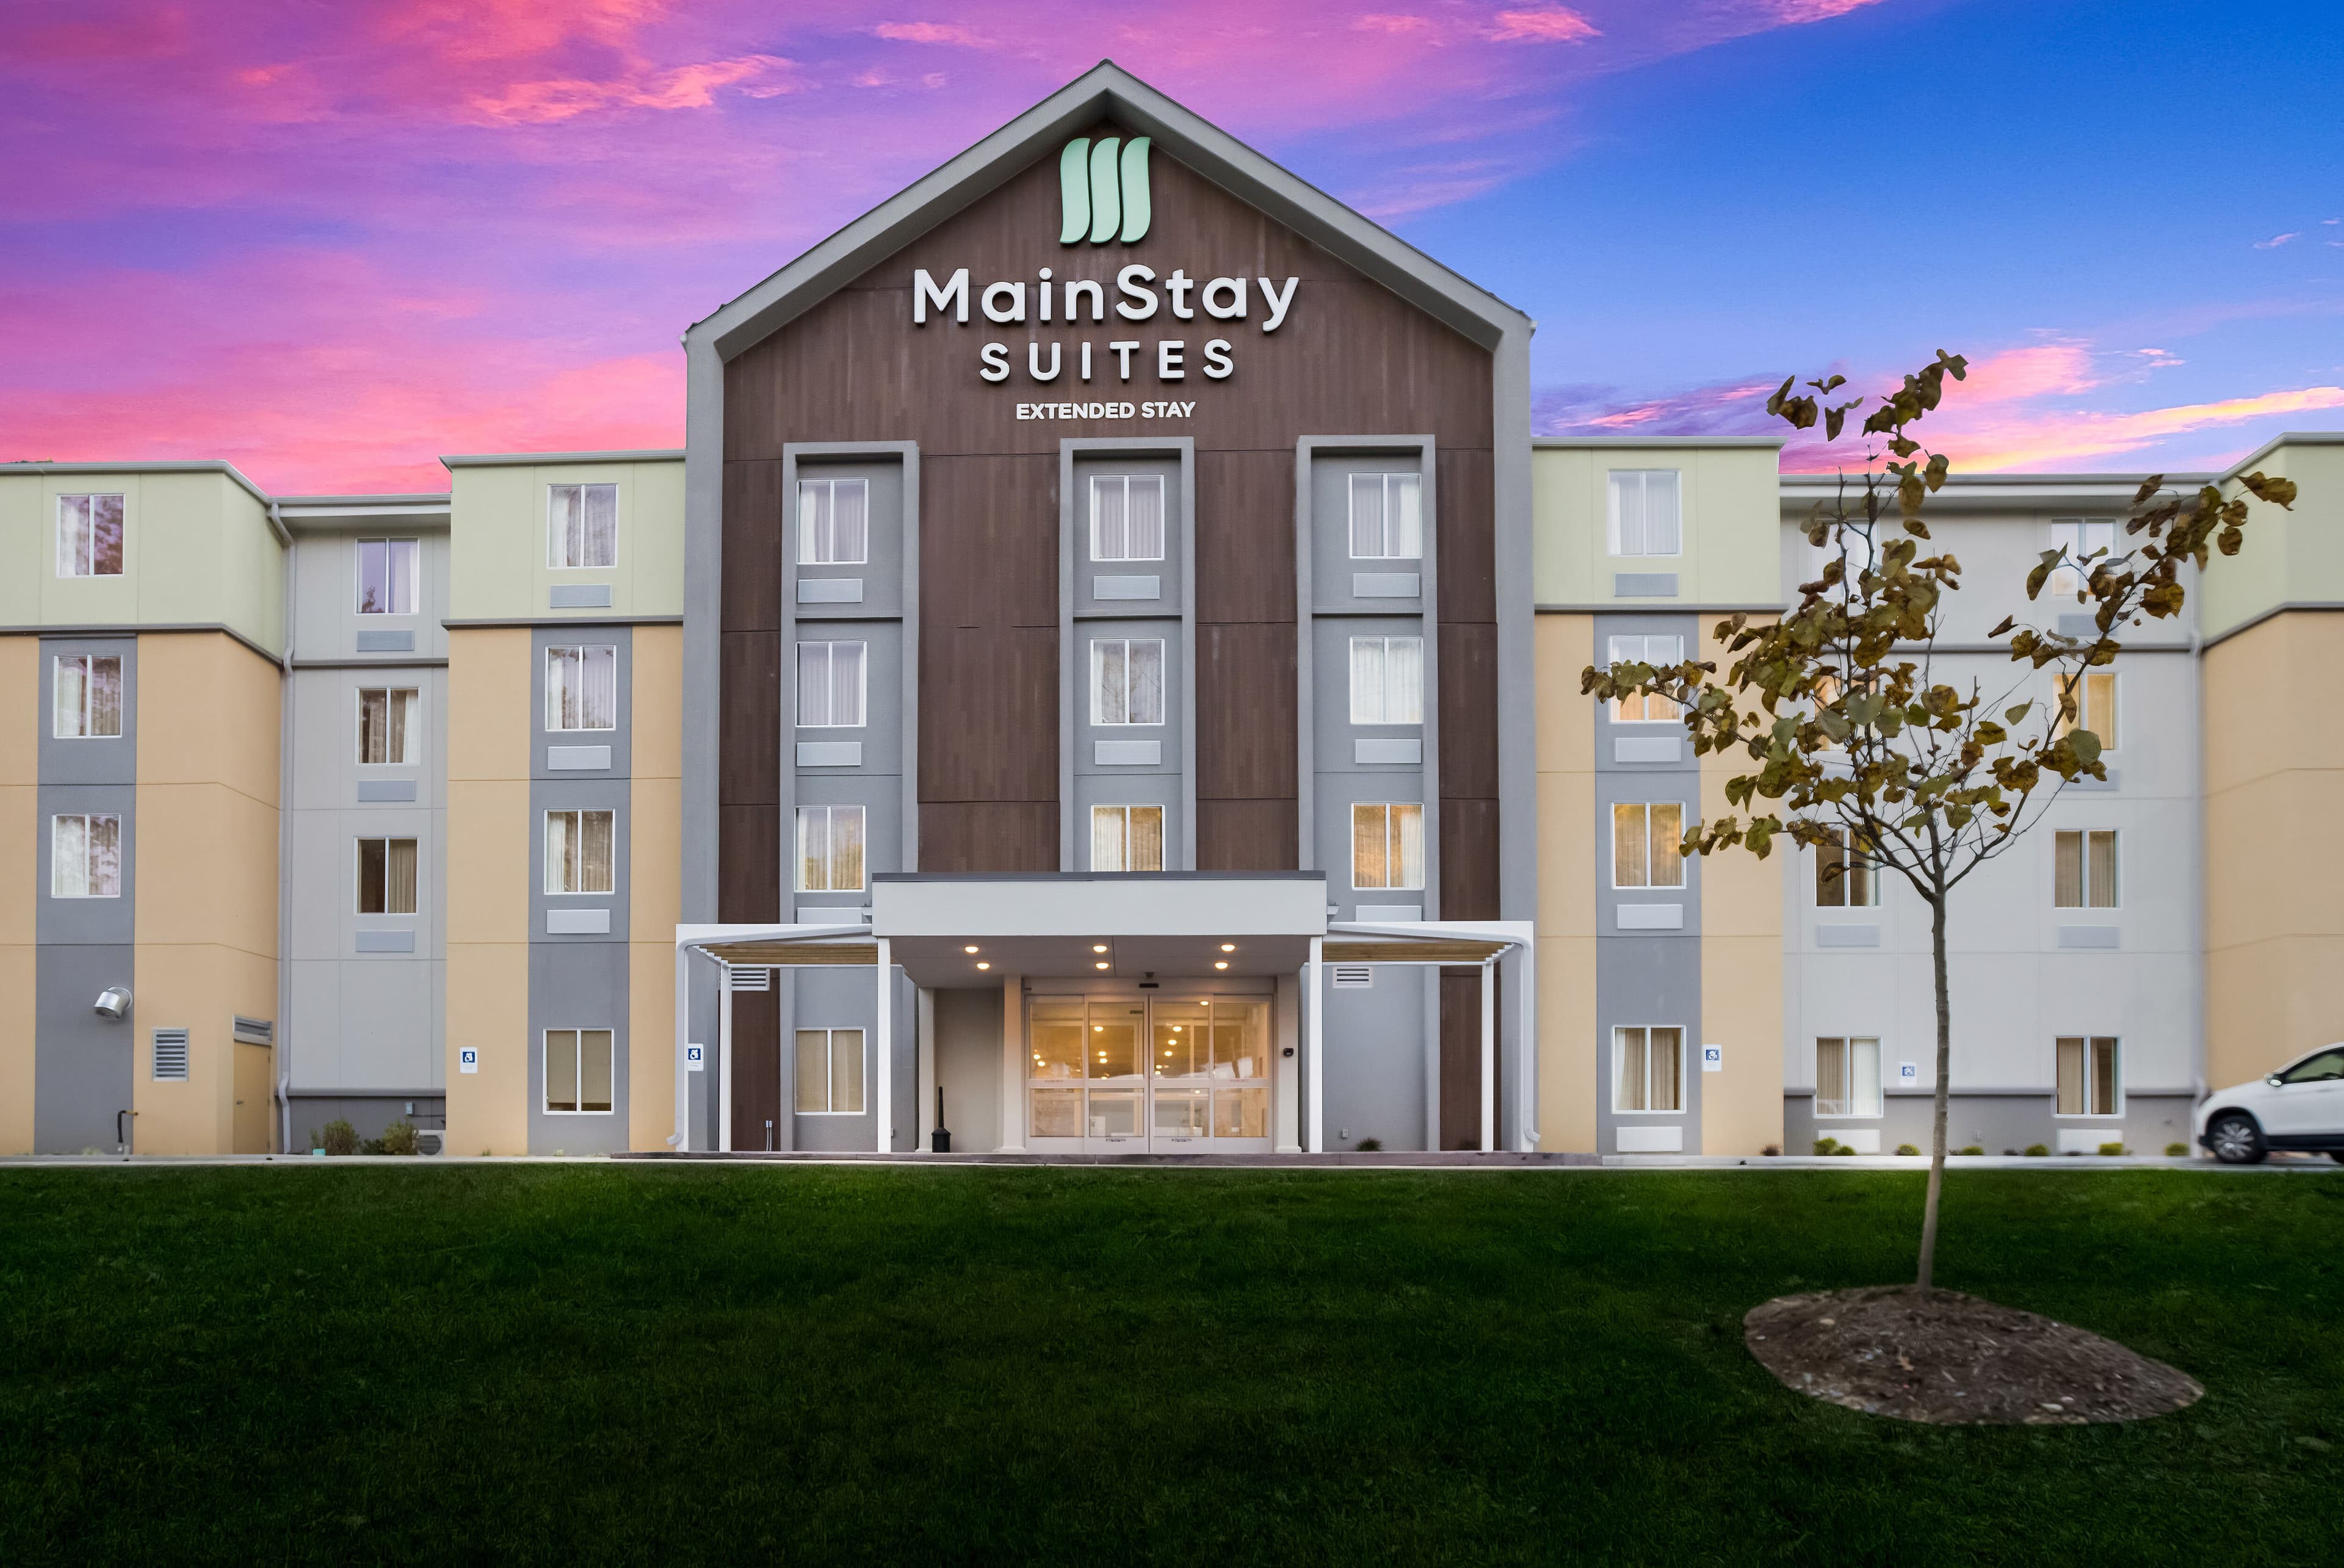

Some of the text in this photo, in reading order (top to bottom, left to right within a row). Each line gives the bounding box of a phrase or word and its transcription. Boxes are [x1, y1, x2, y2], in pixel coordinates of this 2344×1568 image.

[914, 264, 1300, 331] MainStay
[980, 339, 1234, 381] SUITES
[1016, 401, 1196, 420] EXTENDED STAY
